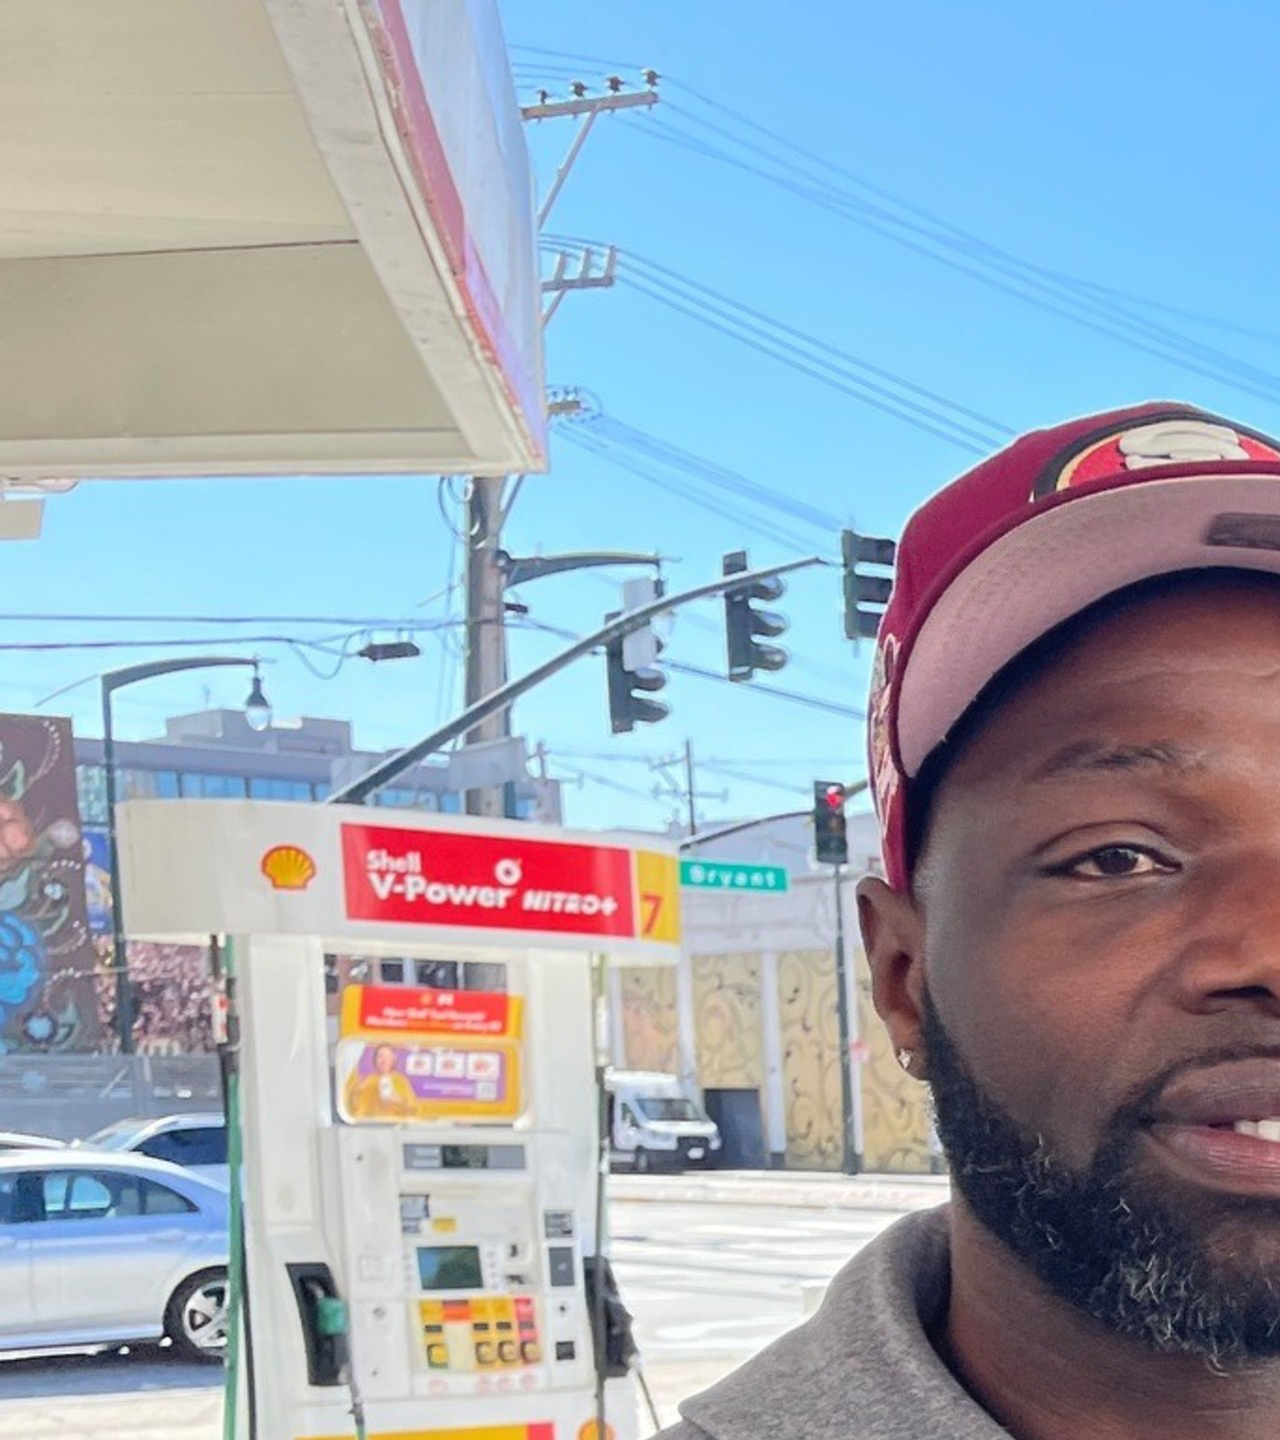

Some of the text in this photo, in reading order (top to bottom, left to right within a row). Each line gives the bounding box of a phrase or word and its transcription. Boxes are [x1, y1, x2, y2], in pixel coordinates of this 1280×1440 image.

[366, 848, 422, 873] Shell
[366, 871, 618, 917] V-Power NITRO+
[689, 864, 776, 892] Bryant
[643, 894, 663, 935] 7
